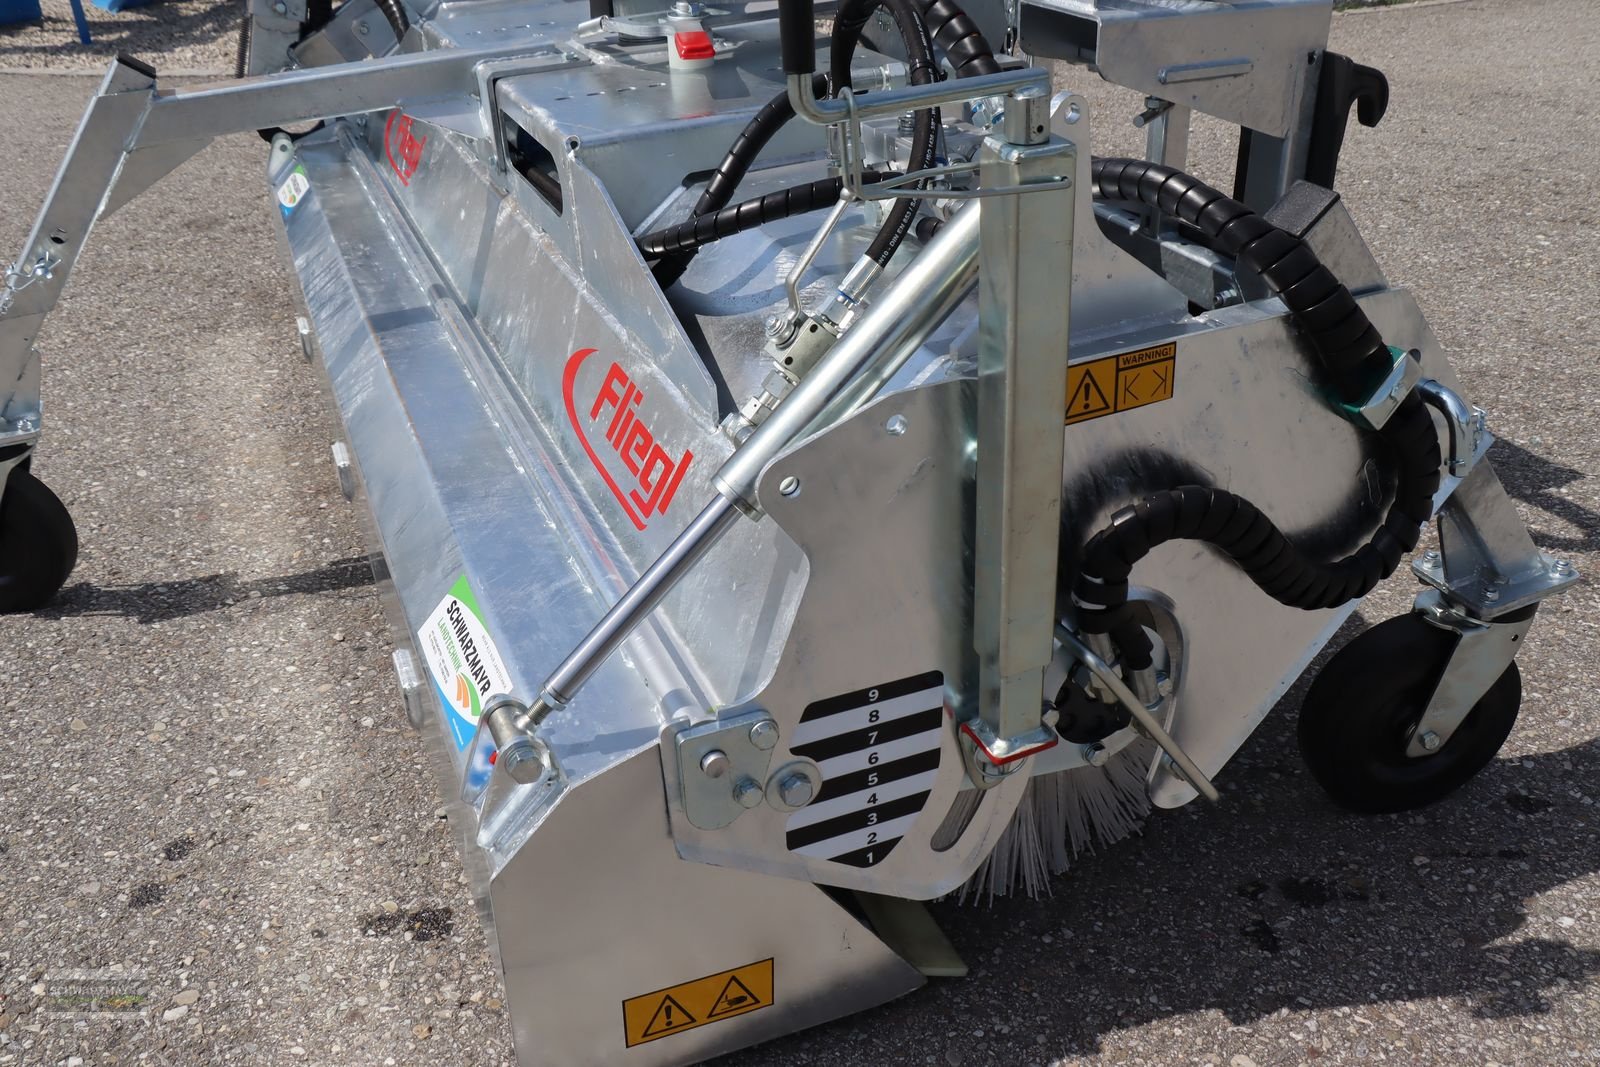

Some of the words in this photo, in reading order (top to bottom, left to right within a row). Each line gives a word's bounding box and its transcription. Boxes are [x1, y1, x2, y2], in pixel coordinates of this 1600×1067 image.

[889, 233, 900, 247] DIN
[897, 223, 905, 234] EN
[1122, 347, 1172, 366] WARNING!
[590, 362, 694, 519] Fliegl
[438, 617, 462, 672] LANDTECHNIK
[447, 600, 491, 696] SCHWARZMAYR
[868, 689, 879, 701] 9
[868, 710, 879, 723] 8
[868, 731, 878, 744] 7
[868, 752, 879, 765] 6
[868, 773, 878, 786] 5
[867, 793, 878, 805] 4
[867, 813, 878, 825] 3
[867, 832, 877, 845] 2
[866, 852, 874, 863] 1
